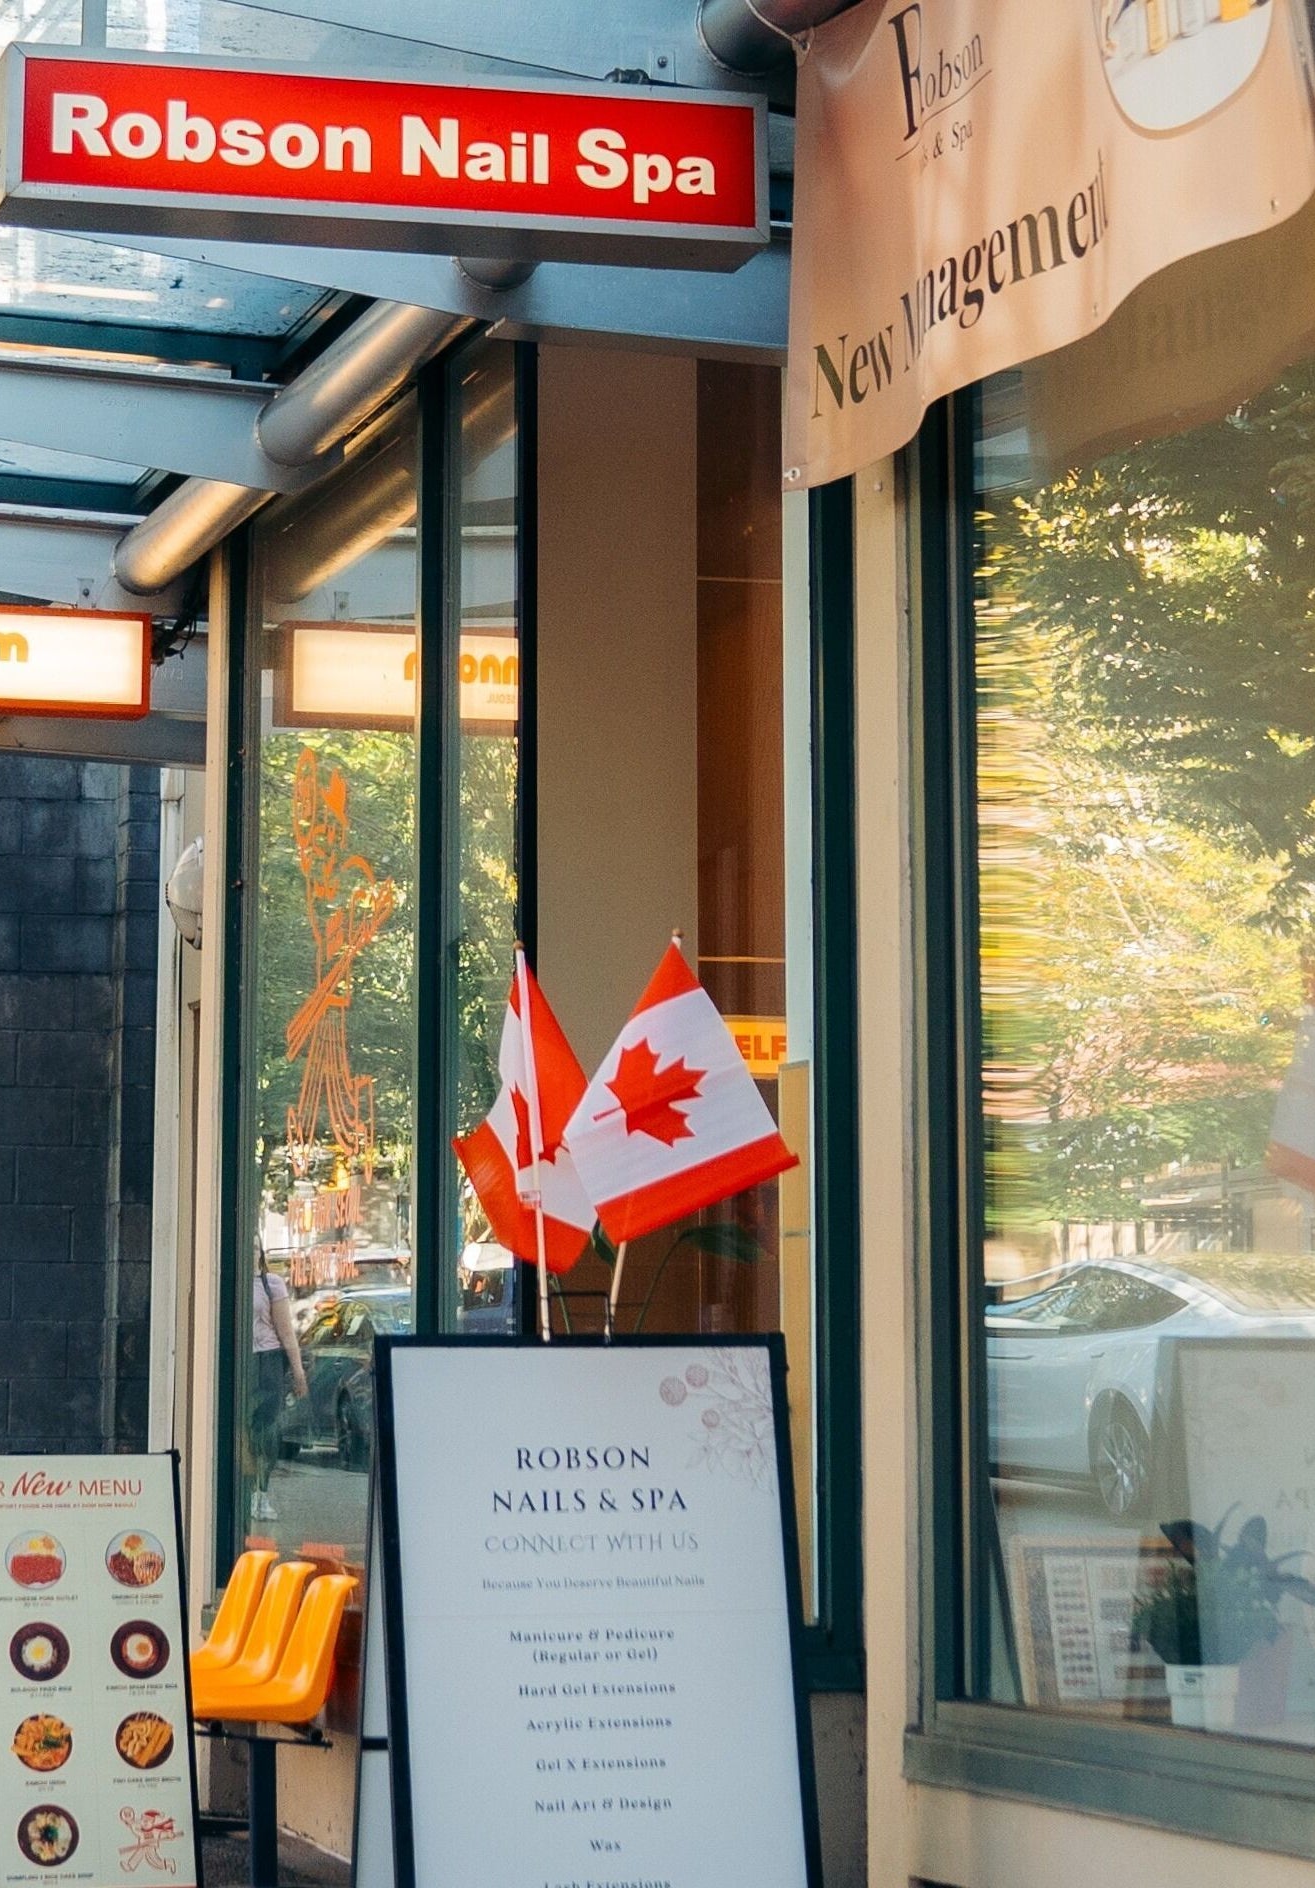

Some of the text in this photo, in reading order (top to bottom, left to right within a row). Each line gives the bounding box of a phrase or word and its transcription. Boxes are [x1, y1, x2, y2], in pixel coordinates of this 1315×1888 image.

[952, 119, 973, 151] Spa
[51, 92, 717, 204] Robson Nail Spa
[811, 325, 894, 419] New
[516, 1446, 651, 1471] ROBSON
[12, 1471, 73, 1497] New
[79, 1479, 142, 1497] MENU
[493, 1487, 688, 1513] NAILS & SPA
[484, 1530, 699, 1554] CONNECT WITH US
[482, 1574, 705, 1590] Because You Deserve Beautiful Nails
[509, 1627, 675, 1643] Manicure & Pedicure
[532, 1646, 658, 1665] (Regular or Gel)
[518, 1681, 676, 1697] Hard Gel Extensions
[526, 1715, 672, 1734] Acrylic Extensions
[535, 1755, 667, 1772] Gel X Extensions
[534, 1796, 672, 1813] Nail Art & Design
[589, 1839, 622, 1852] Wax
